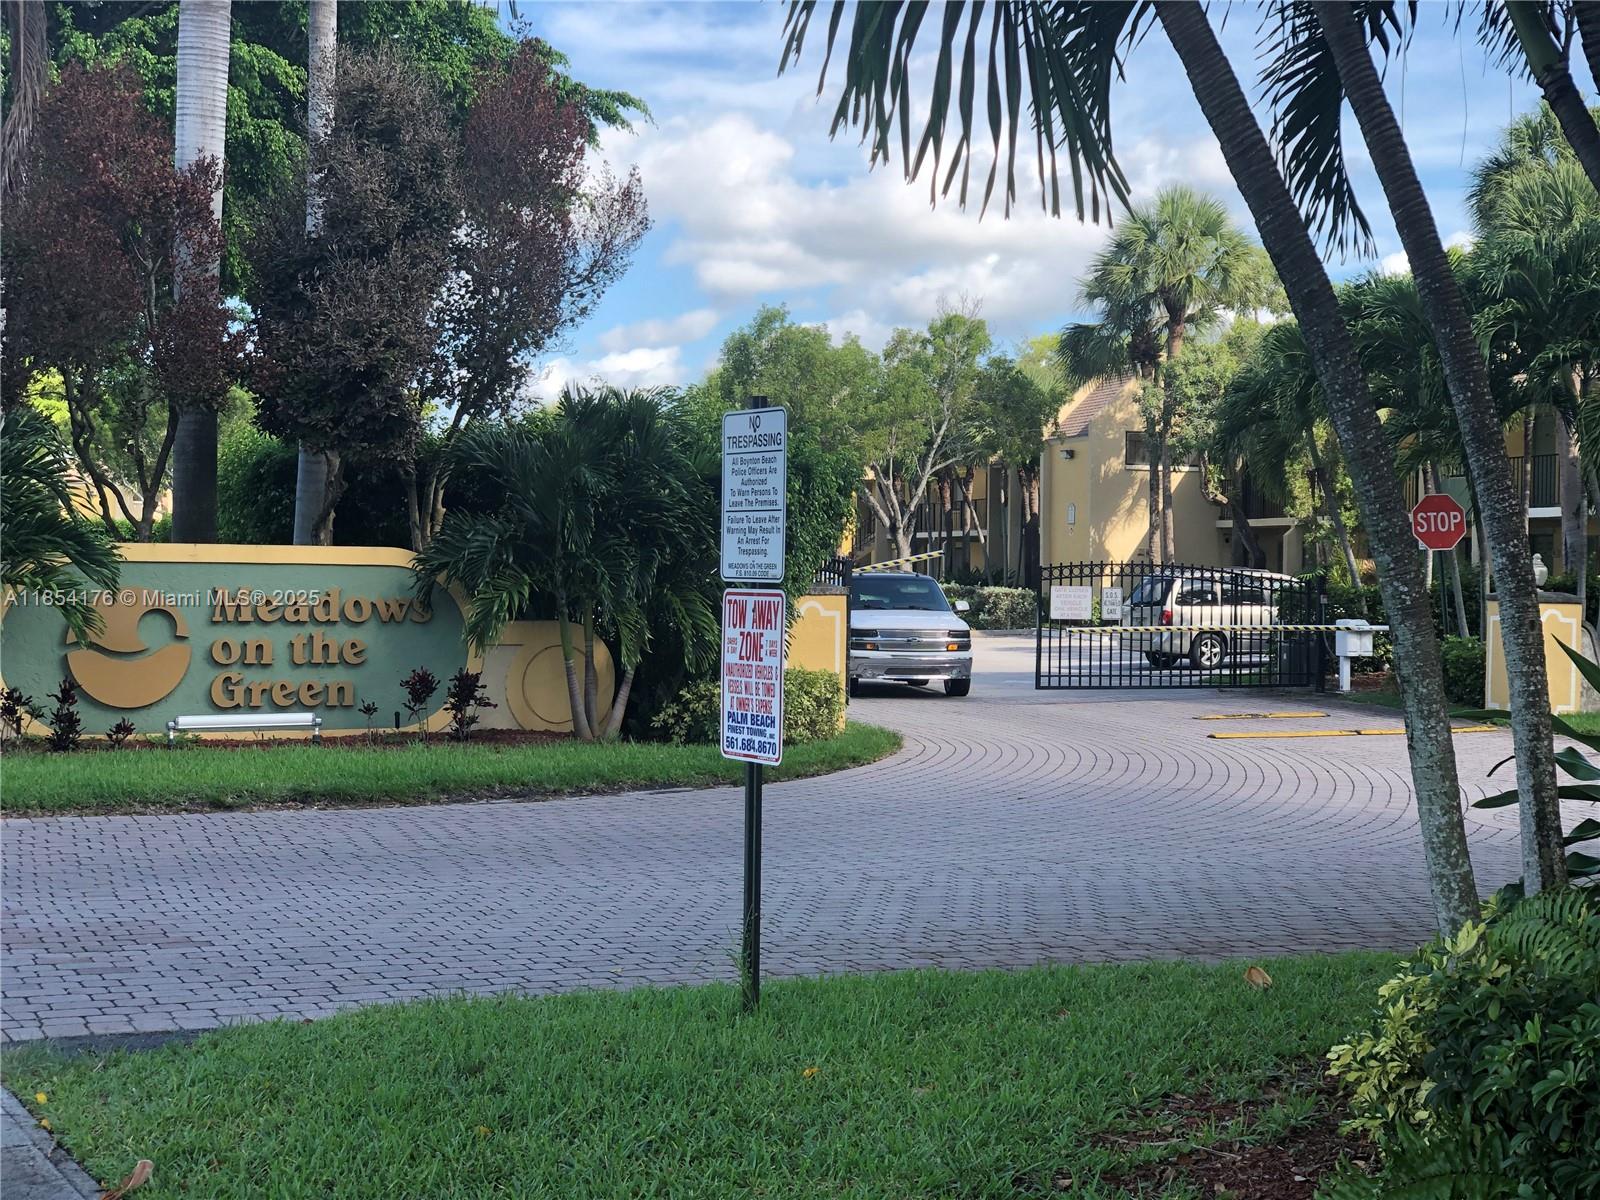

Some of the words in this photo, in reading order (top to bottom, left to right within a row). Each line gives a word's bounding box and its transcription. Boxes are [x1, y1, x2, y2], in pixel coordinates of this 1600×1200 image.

[749, 415, 761, 429] NO
[727, 432, 782, 449] TRESPASSING
[740, 457, 760, 467] Boynton
[762, 455, 777, 464] Beach
[732, 468, 746, 476] Police
[748, 467, 767, 475] Officers
[769, 466, 777, 474] Are
[741, 477, 767, 486] Authorized
[751, 487, 771, 496] Persons
[772, 487, 778, 495] To
[729, 499, 743, 507] Leave
[744, 498, 753, 506] The
[727, 515, 744, 524] Failure
[745, 515, 751, 523] To
[752, 515, 767, 523] Leave
[768, 515, 780, 523] After
[1417, 511, 1461, 533] STOP
[726, 526, 746, 536] Warning
[748, 526, 758, 536] May
[760, 525, 775, 534] Result
[761, 536, 770, 544] For
[211, 586, 433, 623] Meadows
[727, 599, 747, 629] TOW
[752, 600, 780, 630] AWAY
[211, 638, 274, 665] on
[289, 629, 368, 665] the
[739, 631, 764, 662] ZONE
[211, 671, 355, 708] Green
[727, 711, 748, 725] PALM
[751, 714, 775, 728] BEACH
[727, 725, 745, 735] FINEST
[726, 736, 777, 755] 561.684.8670
